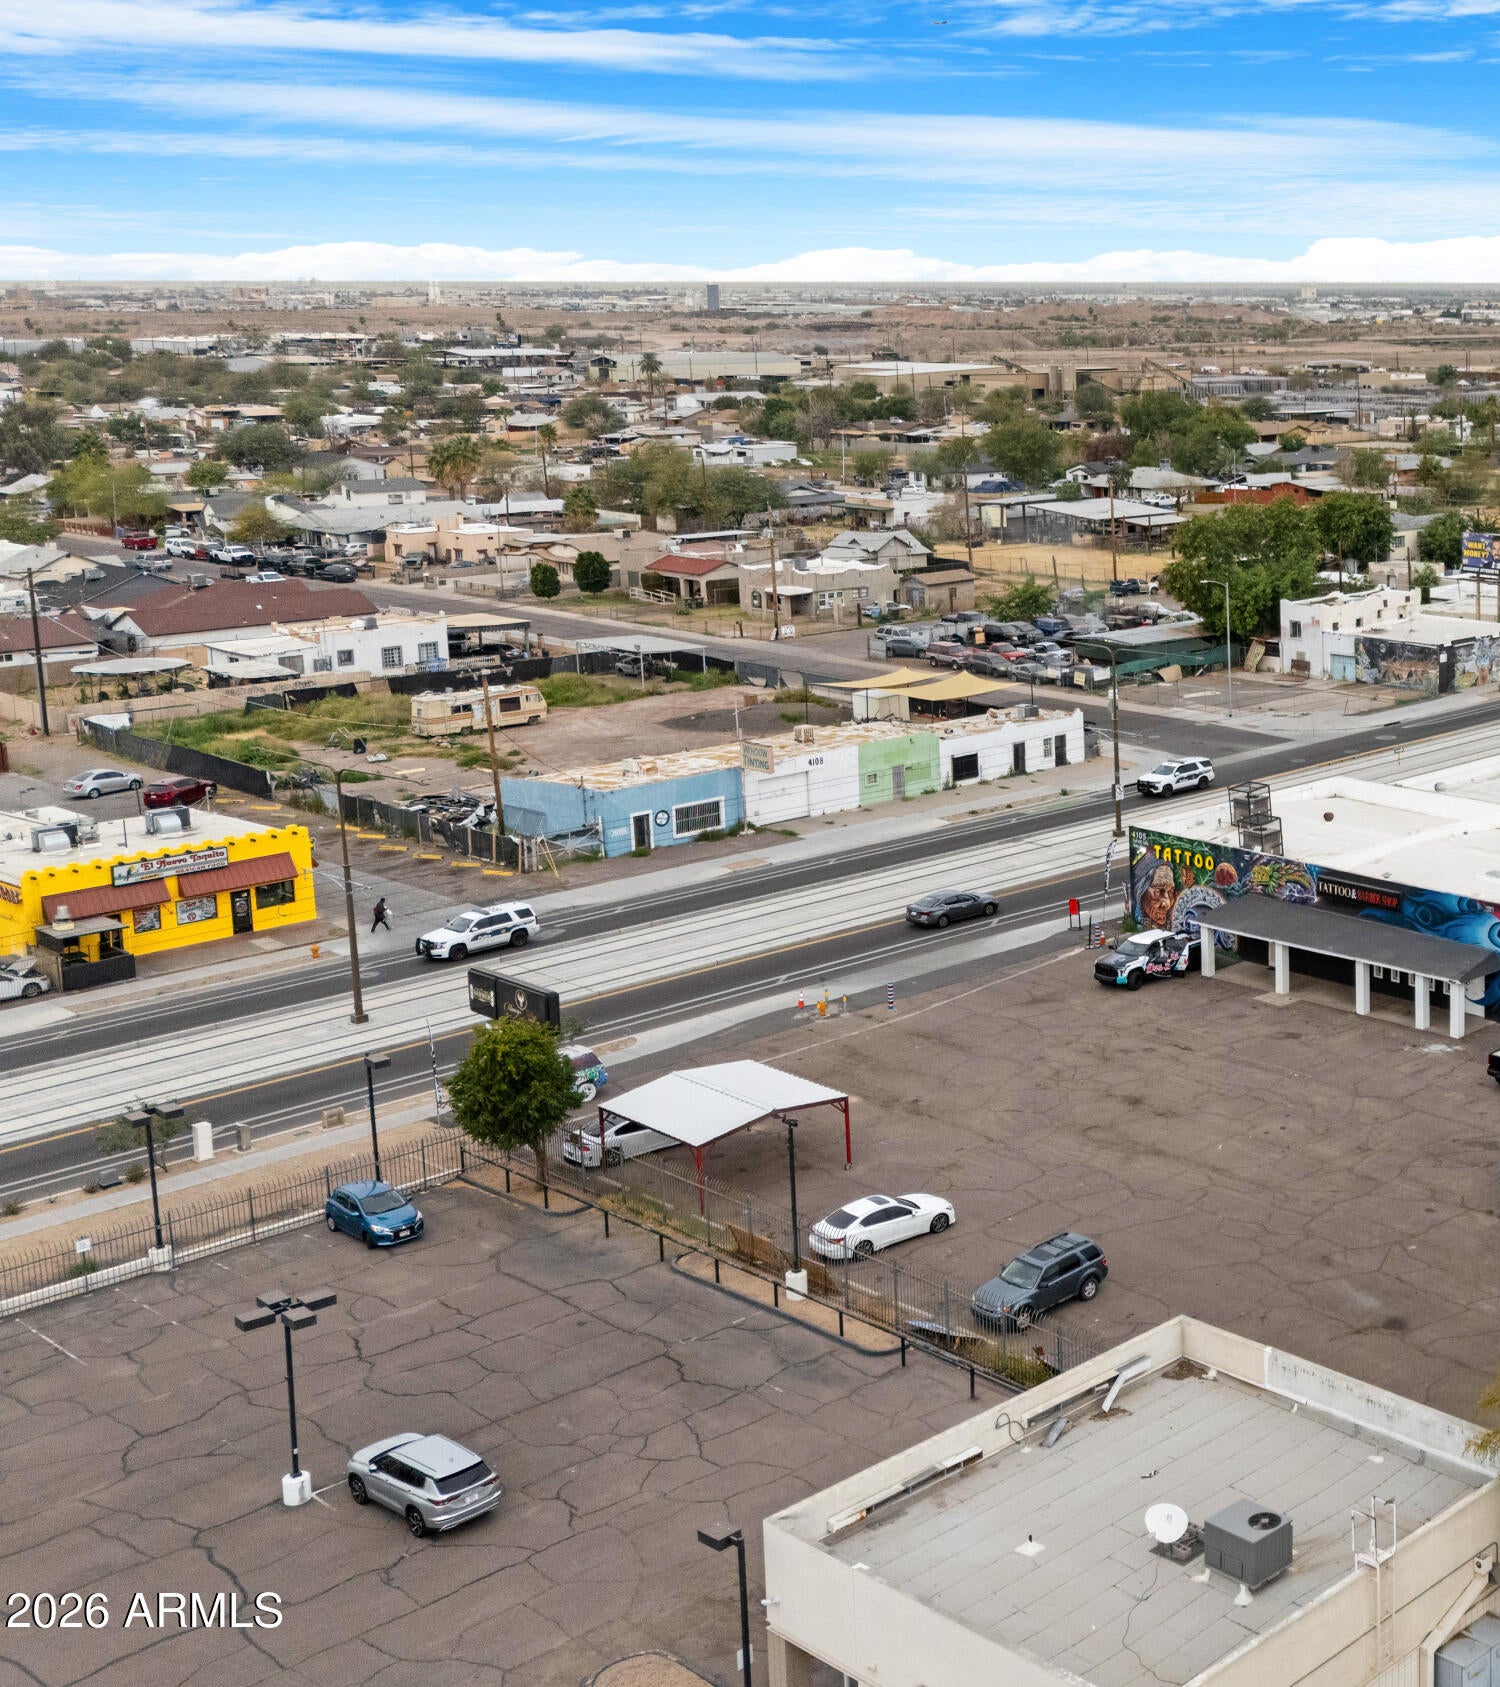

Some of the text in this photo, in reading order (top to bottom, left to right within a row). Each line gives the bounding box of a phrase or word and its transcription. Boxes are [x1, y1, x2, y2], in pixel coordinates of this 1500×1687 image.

[1467, 541, 1486, 550] WANT
[1463, 549, 1489, 559] MONEY?
[743, 743, 768, 758] WINDOW
[743, 755, 769, 770] TINTING
[808, 757, 824, 766] 4108
[140, 851, 225, 871] El Nuevo Taquito
[1153, 844, 1215, 871] TATTOO
[175, 861, 226, 874] MEXICAN FOOD
[1381, 895, 1398, 907] SHOP
